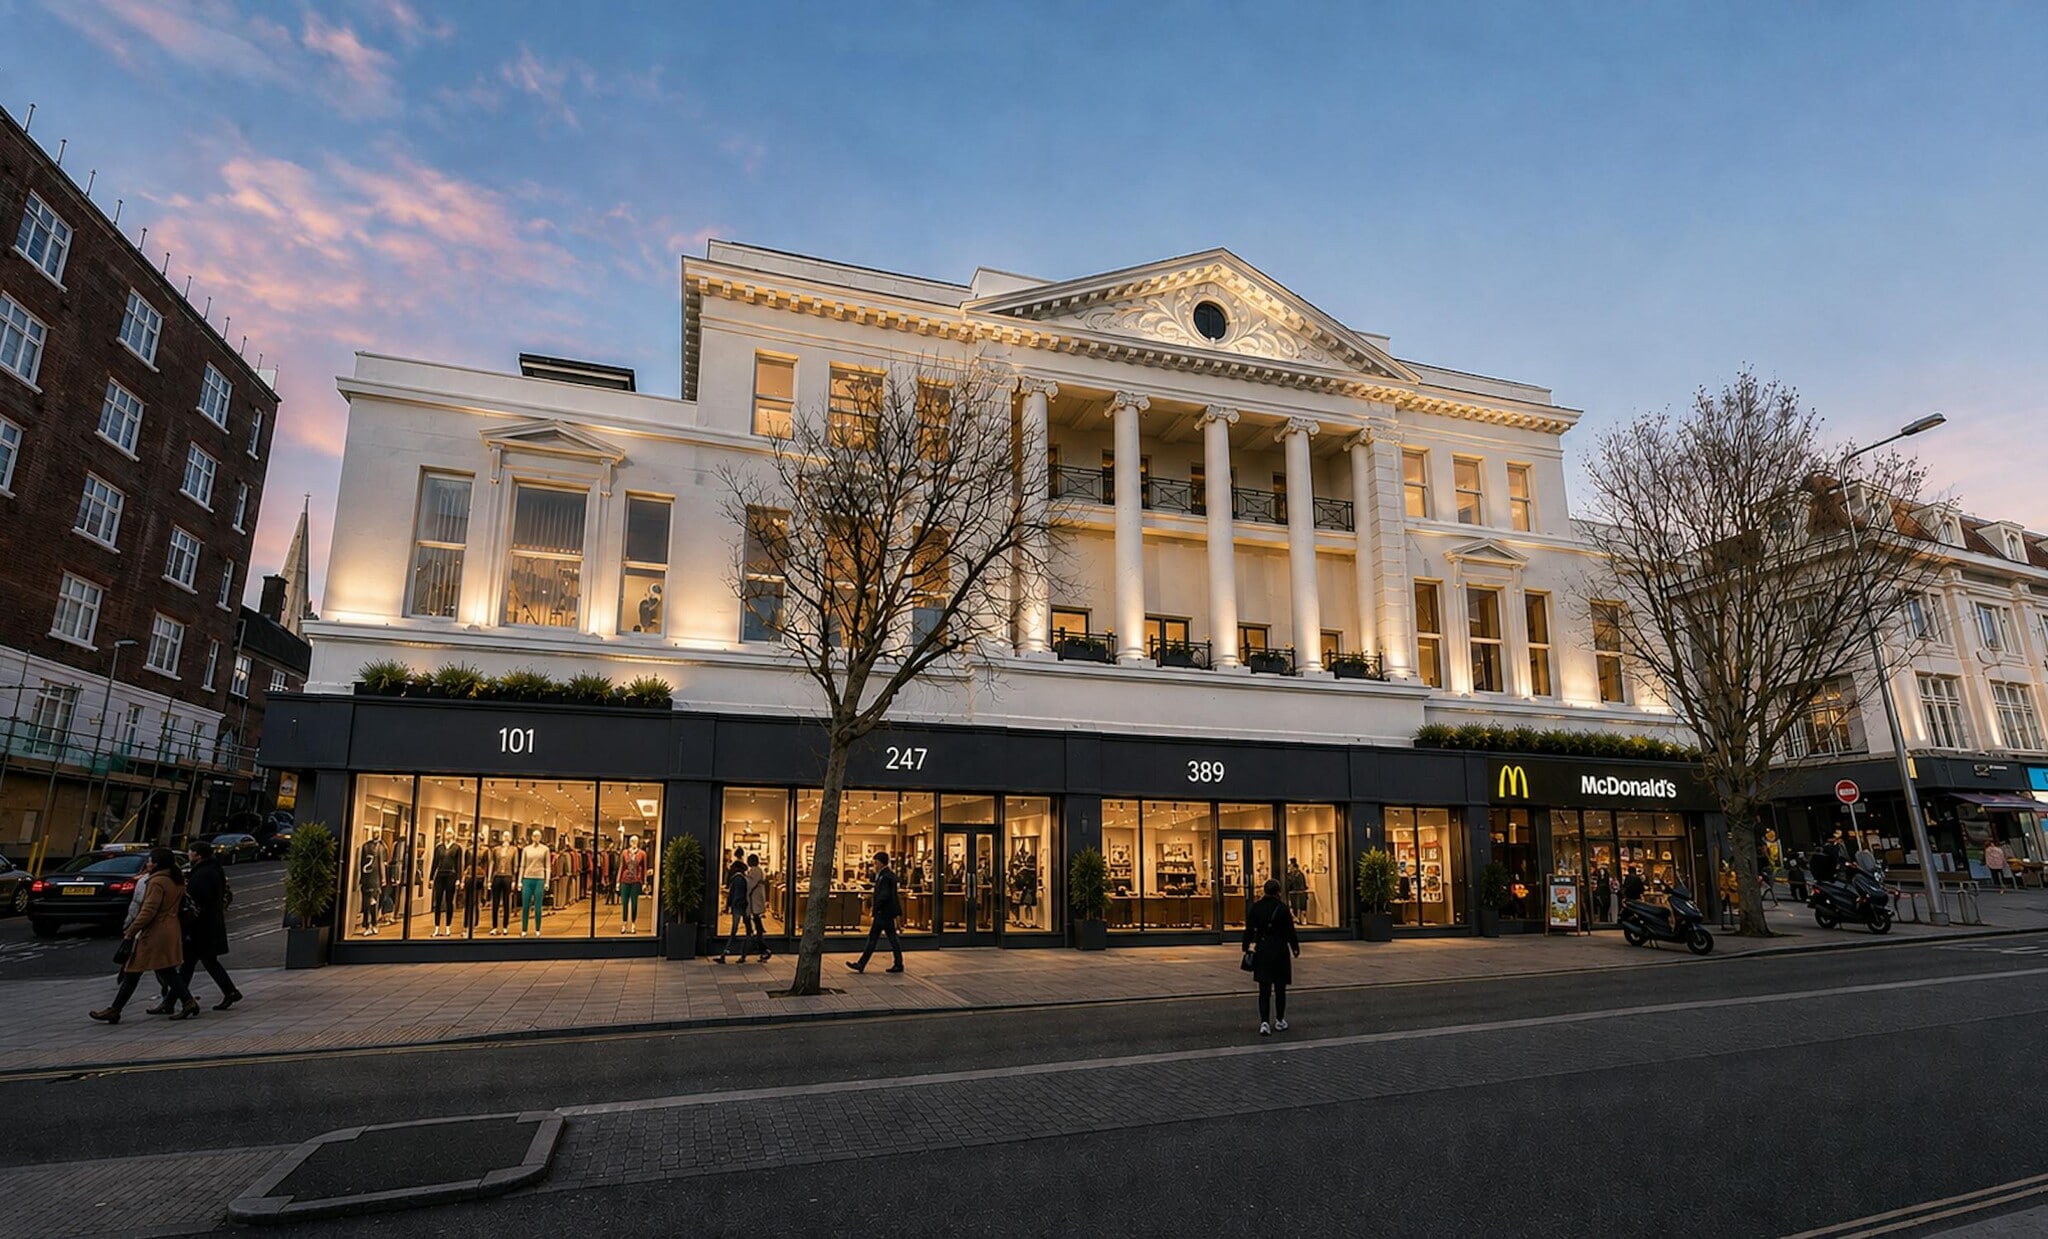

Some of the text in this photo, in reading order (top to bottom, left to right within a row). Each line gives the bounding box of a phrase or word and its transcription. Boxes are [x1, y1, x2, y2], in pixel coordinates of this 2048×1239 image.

[499, 727, 534, 753] 101
[885, 746, 928, 770] 247
[1187, 760, 1225, 783] 389
[1580, 775, 1677, 799] McDonald's
